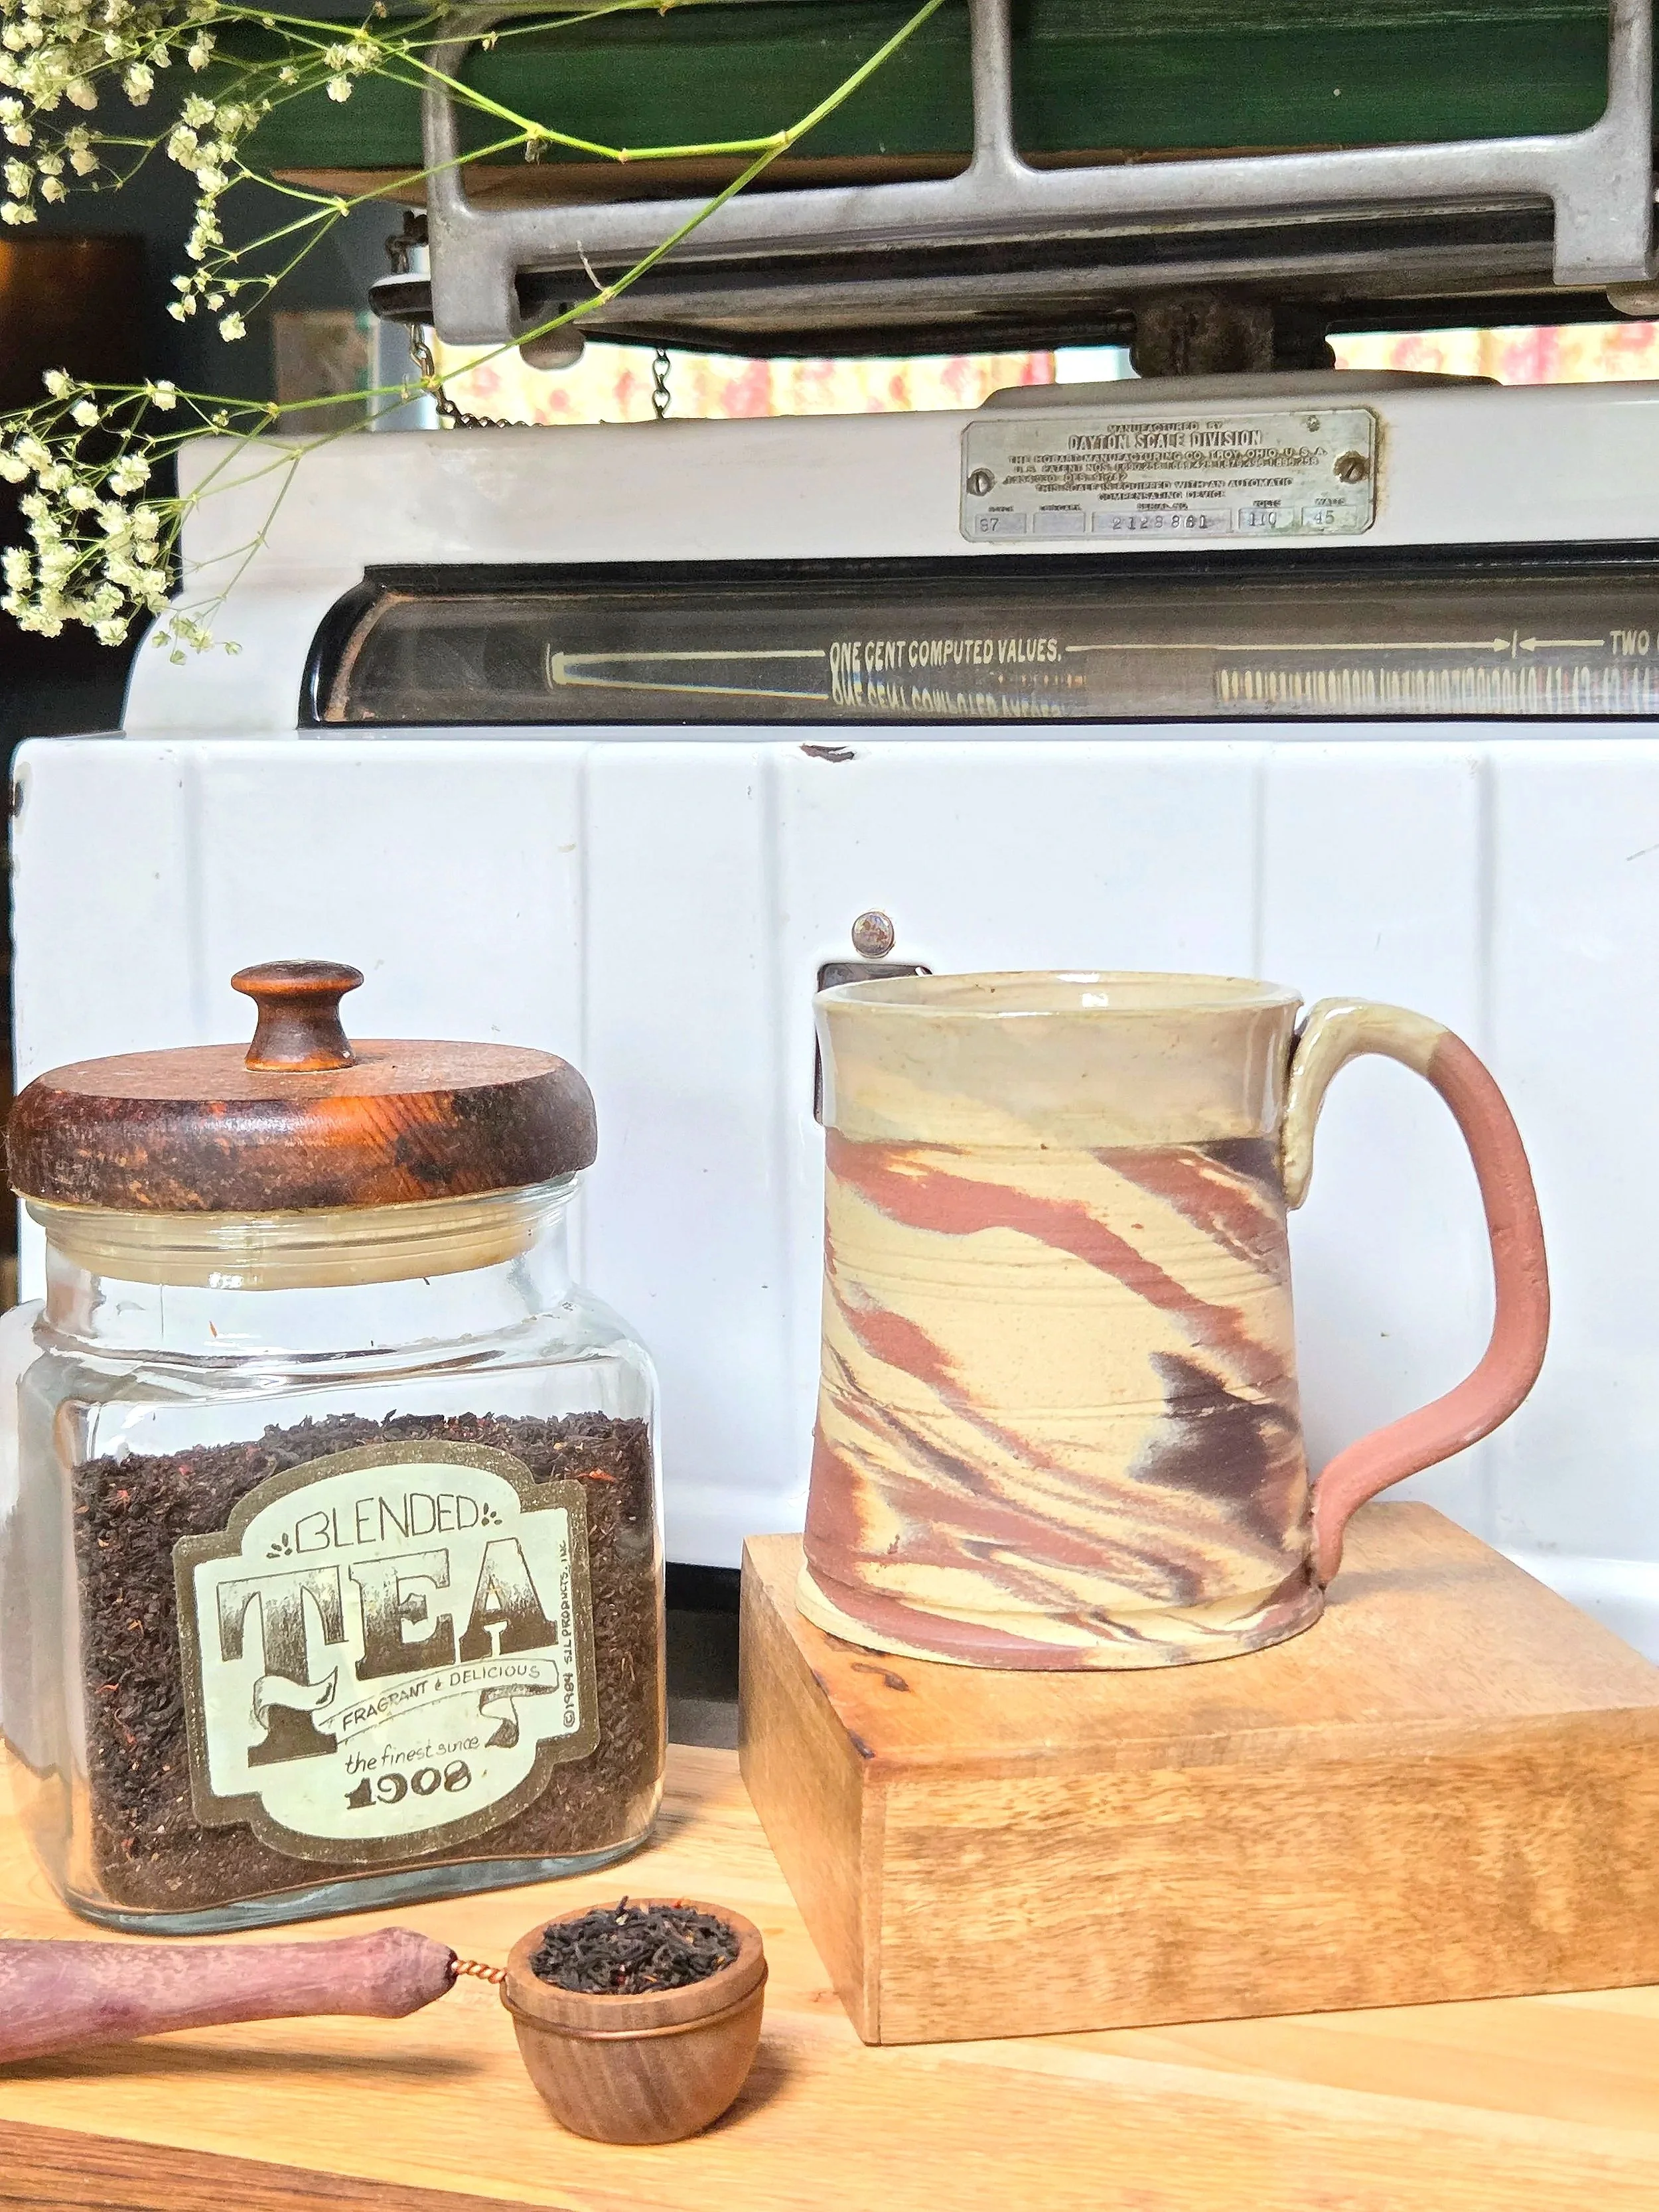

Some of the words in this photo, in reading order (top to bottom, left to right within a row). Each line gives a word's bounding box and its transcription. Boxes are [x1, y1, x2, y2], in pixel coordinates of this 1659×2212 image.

[1068, 434, 1130, 450] DAYTON
[1134, 432, 1185, 449] SCALE
[1190, 430, 1262, 447] DIVISION
[1313, 510, 1335, 525] 45
[830, 642, 861, 673] ONE
[865, 640, 906, 672] CENT
[909, 639, 993, 668] COMPUTED
[1610, 630, 1650, 656] TWO
[296, 1493, 478, 1554] BLENDED
[216, 1537, 559, 1768] TEA
[342, 1680, 428, 1731] FRAGRANT
[450, 1664, 541, 1687] DELICIOUS
[344, 1751, 378, 1775] the
[382, 1743, 434, 1767] finest
[344, 1759, 472, 1810] 1908
